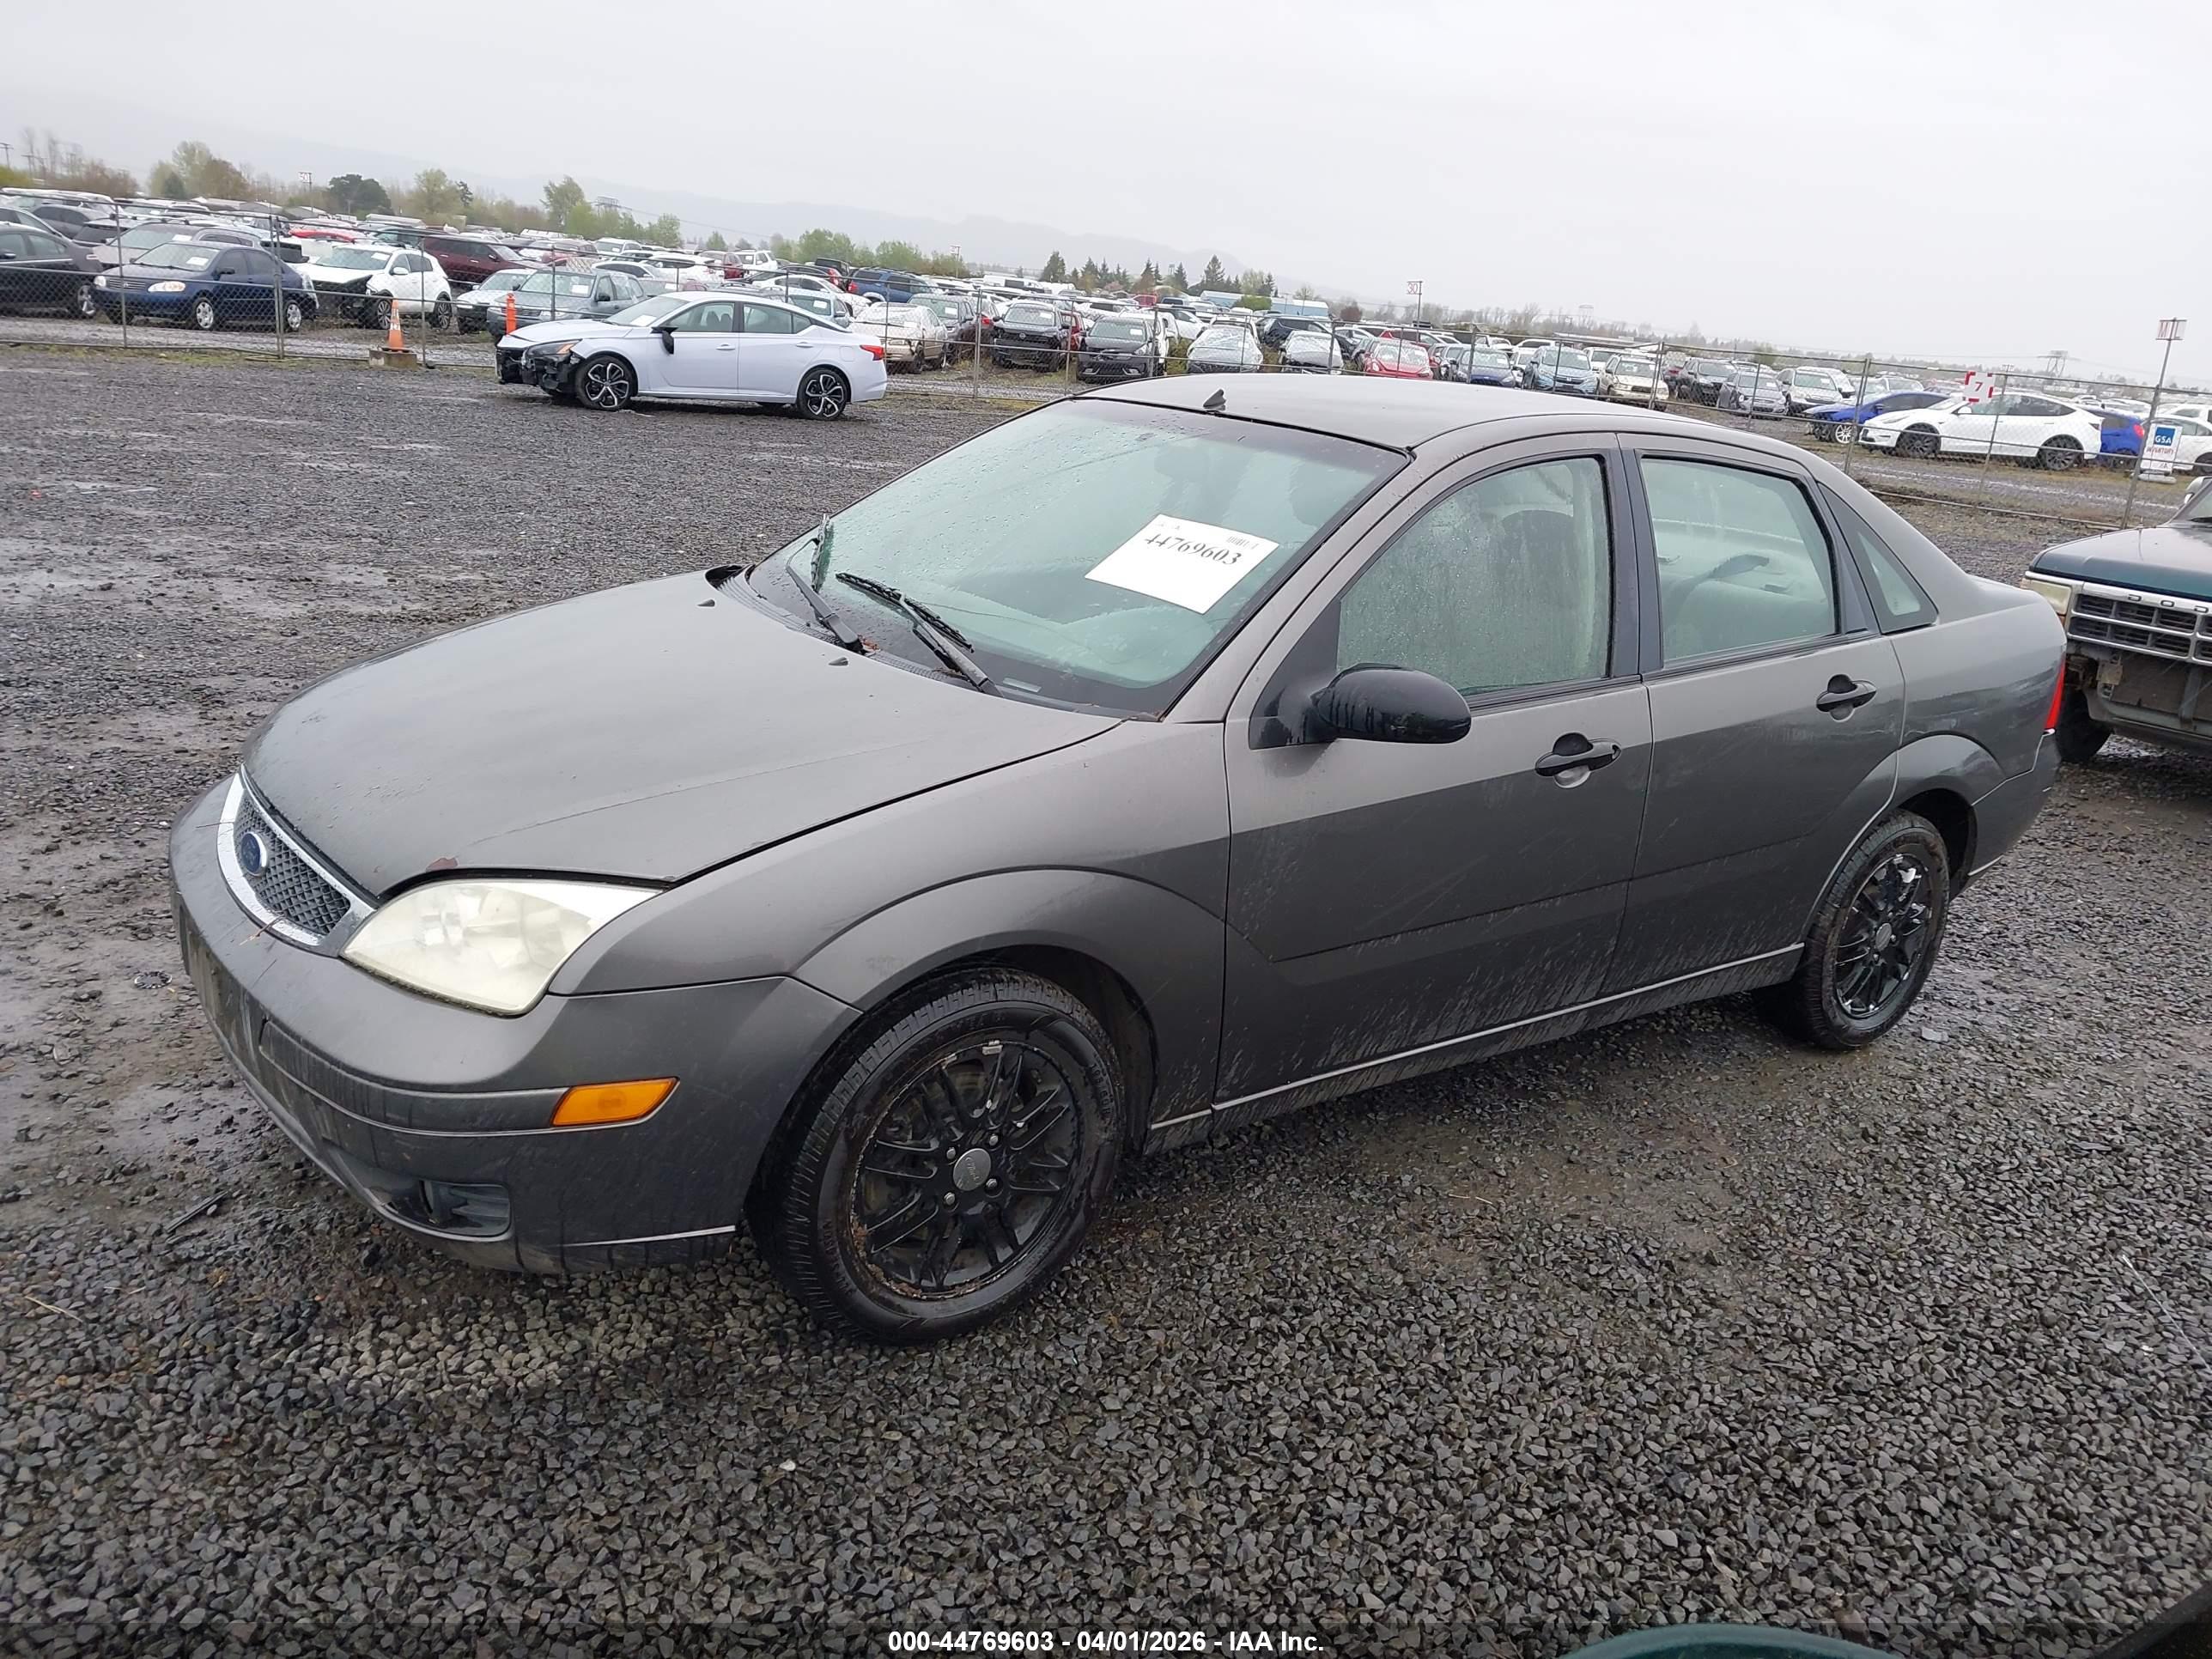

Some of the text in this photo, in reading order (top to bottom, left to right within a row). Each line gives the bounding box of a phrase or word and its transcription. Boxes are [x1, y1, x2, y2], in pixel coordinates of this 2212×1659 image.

[1975, 381, 1984, 392] 7
[2154, 434, 2172, 444] GSA
[1144, 533, 1242, 564] 44769603
